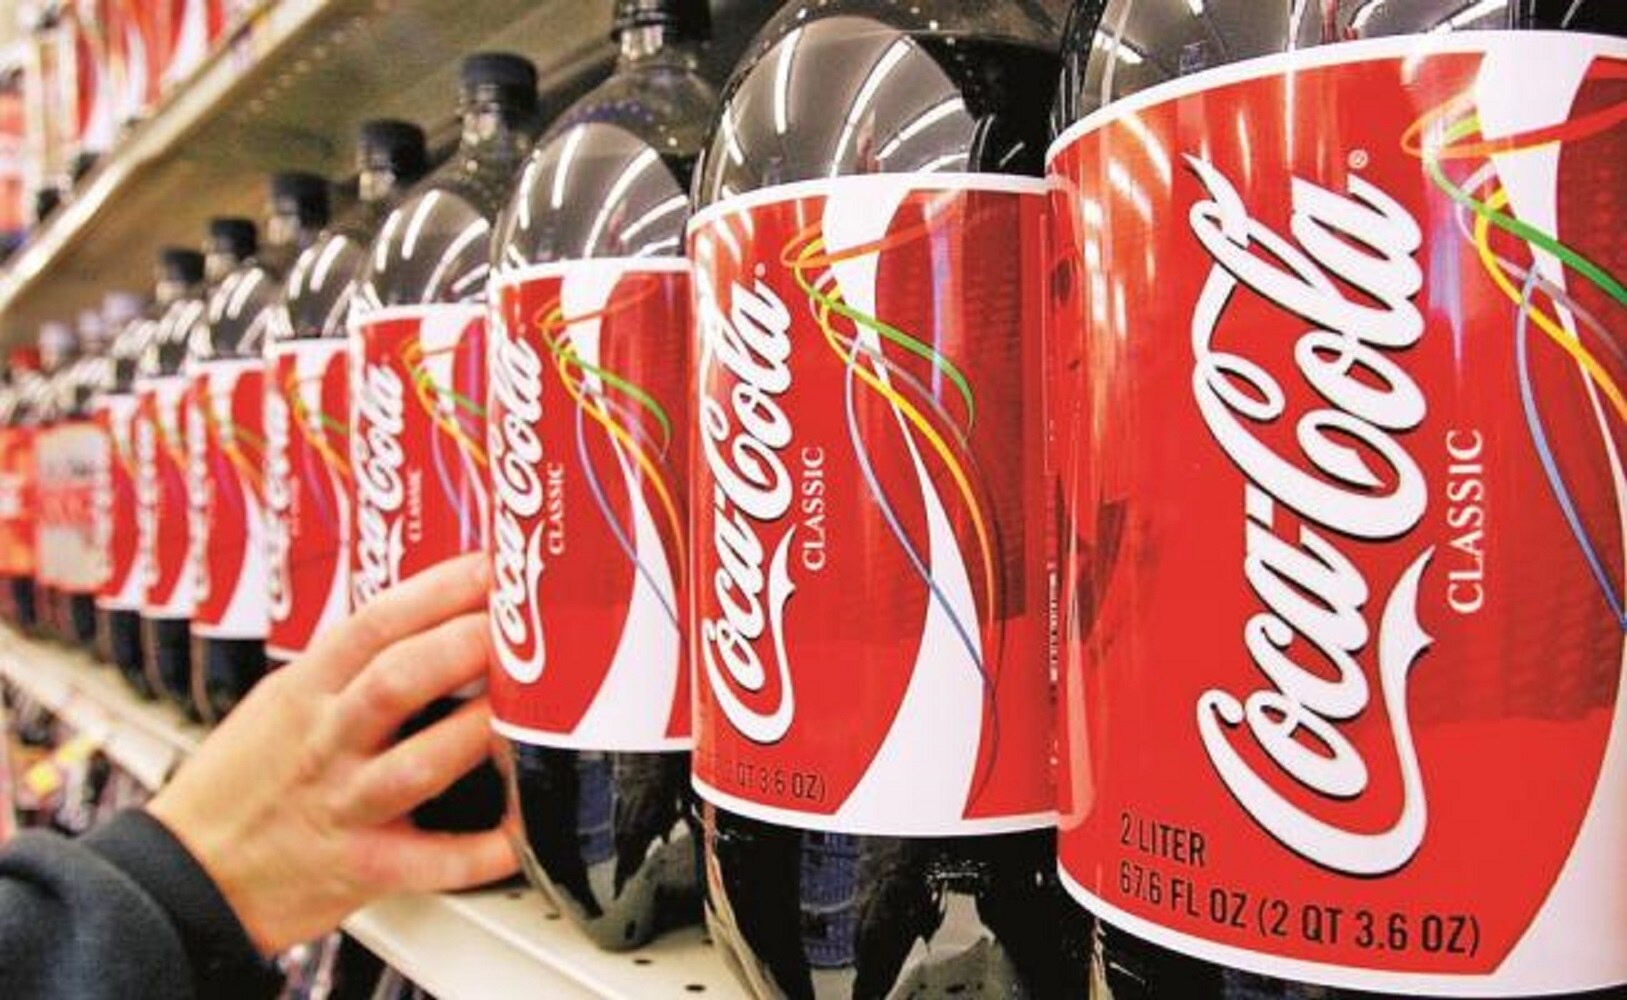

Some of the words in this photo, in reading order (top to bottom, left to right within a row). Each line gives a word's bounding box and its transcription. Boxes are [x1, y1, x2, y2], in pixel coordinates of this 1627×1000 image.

[547, 462, 565, 555] CLASSIC
[802, 446, 826, 571] CLASSIC
[1446, 429, 1485, 615] CLASSIC
[792, 771, 826, 803] OZ)
[1120, 812, 1131, 846] 2
[1138, 818, 1206, 868] LITER
[1120, 860, 1162, 906] 67.6
[1171, 877, 1201, 918] FL
[1209, 887, 1248, 929] OZ
[1257, 897, 1290, 937] (2
[1301, 904, 1343, 945] QT
[1354, 910, 1409, 952] 3.6
[1421, 914, 1481, 959] OZ)
